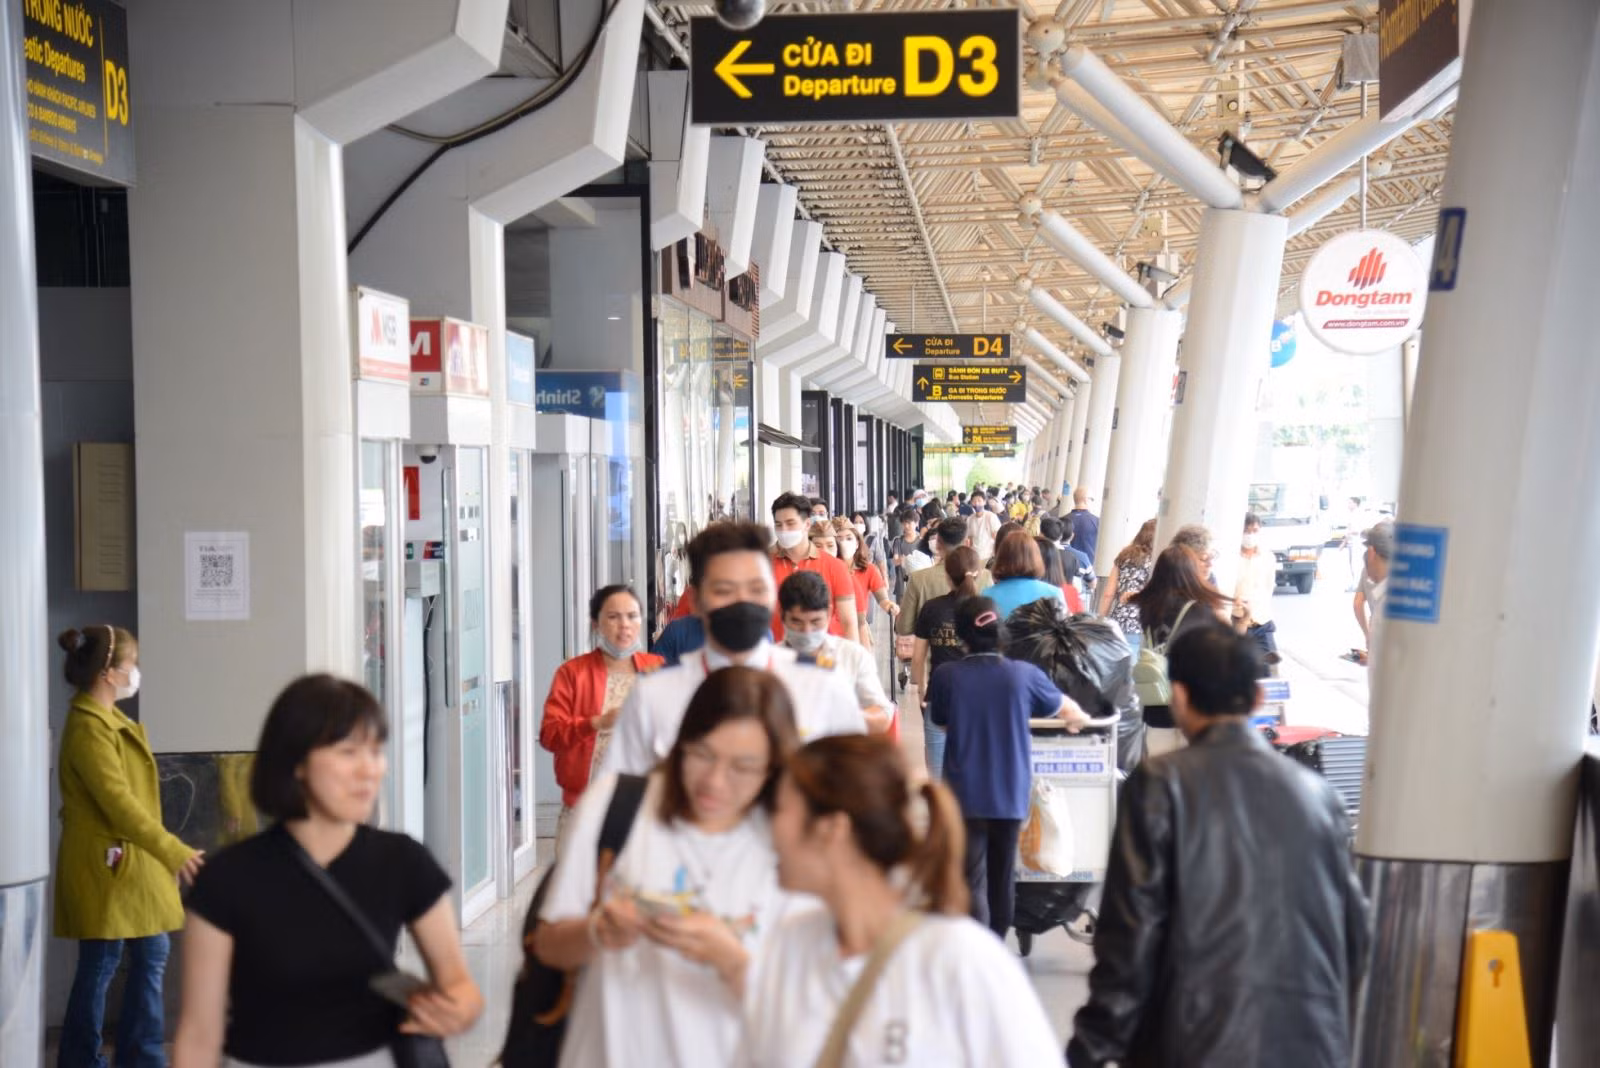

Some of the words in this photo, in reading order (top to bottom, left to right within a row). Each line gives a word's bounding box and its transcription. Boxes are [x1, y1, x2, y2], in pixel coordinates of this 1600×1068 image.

[64, 3, 94, 48] NƯỚC
[45, 40, 86, 83] Departures
[783, 36, 839, 67] CỬA
[846, 43, 872, 66] ĐI
[905, 35, 998, 97] D3
[105, 59, 129, 126] D3
[784, 75, 897, 101] Departure
[1315, 290, 1412, 308] Dongtam
[1327, 320, 1405, 328] www.dongtam.com.vn
[925, 337, 943, 346] CỬA
[944, 338, 953, 346] ĐI
[925, 348, 960, 356] Departure
[973, 336, 1004, 356] D4
[932, 385, 942, 396] B
